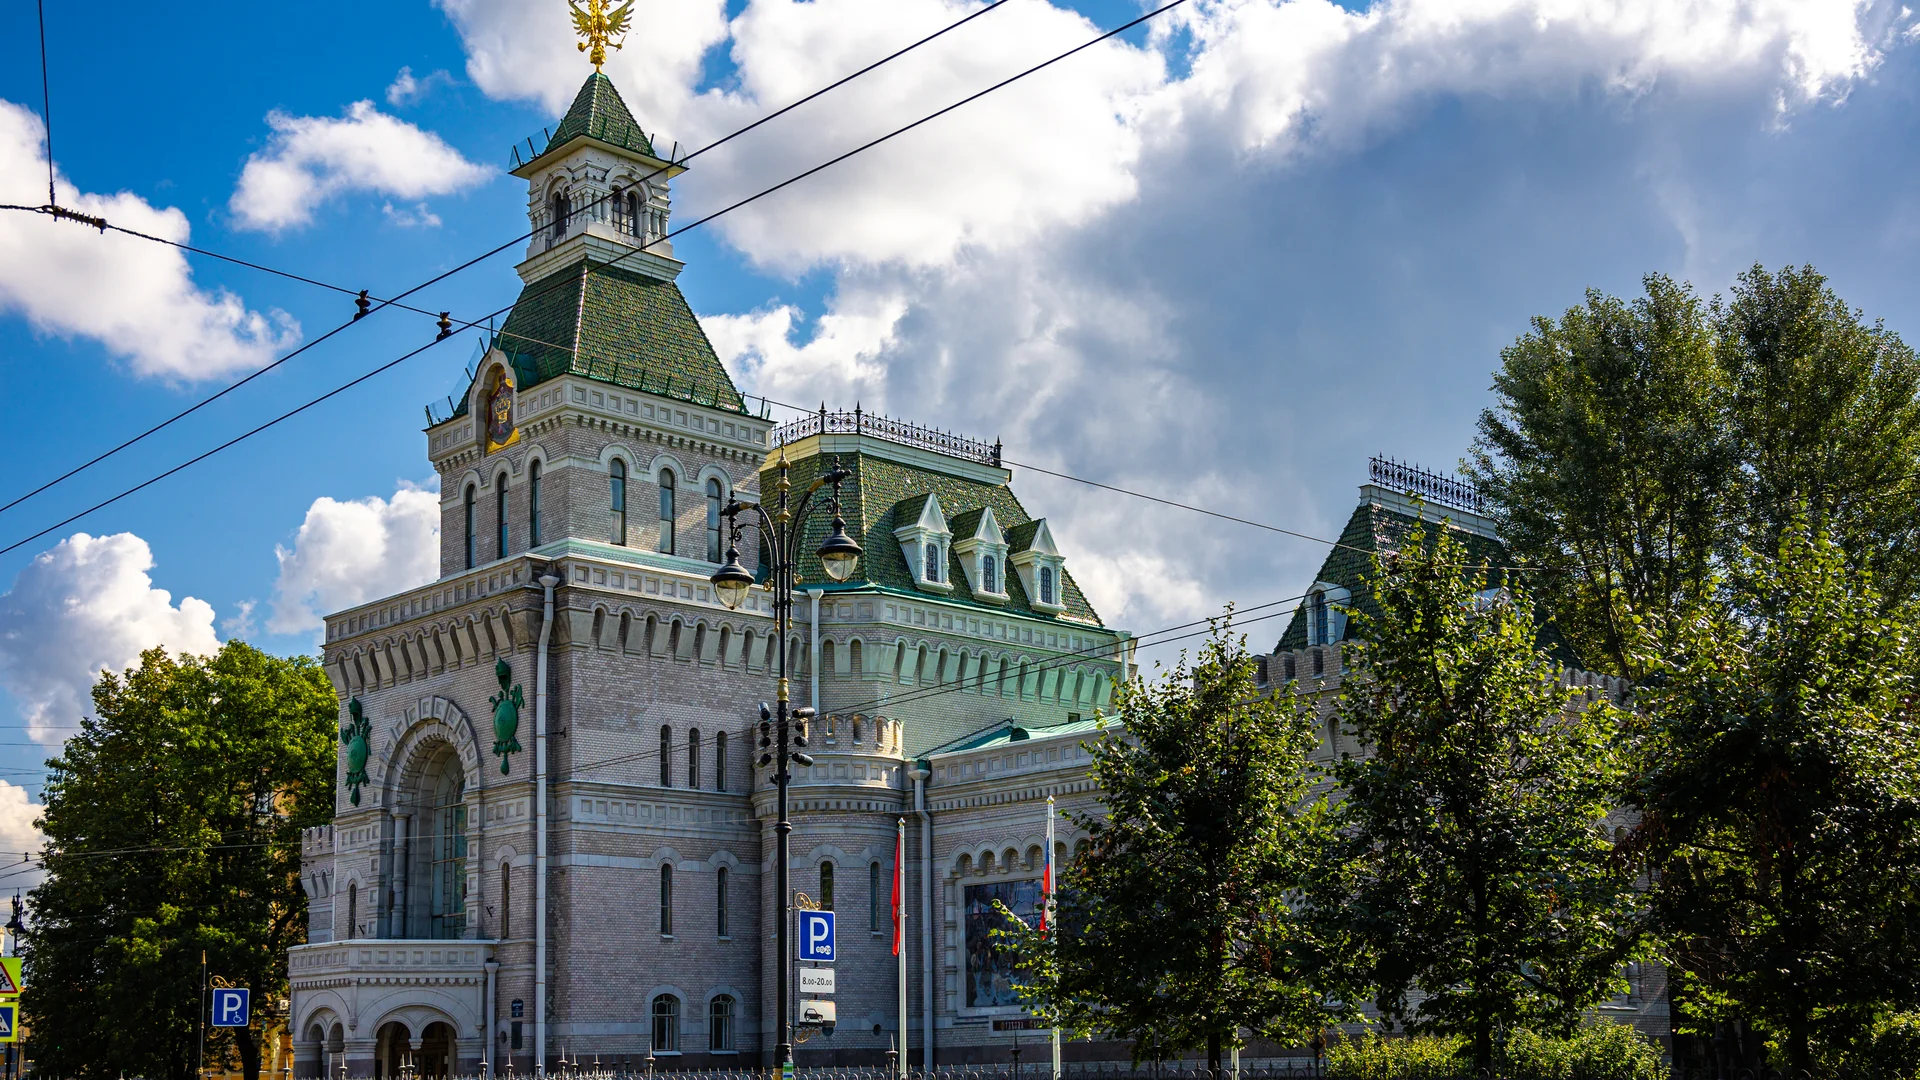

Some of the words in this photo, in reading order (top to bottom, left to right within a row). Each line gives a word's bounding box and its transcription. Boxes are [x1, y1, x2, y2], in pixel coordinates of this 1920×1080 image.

[810, 917, 829, 954] P
[802, 976, 833, 986] 8.00-20.00
[223, 993, 242, 1022] P
